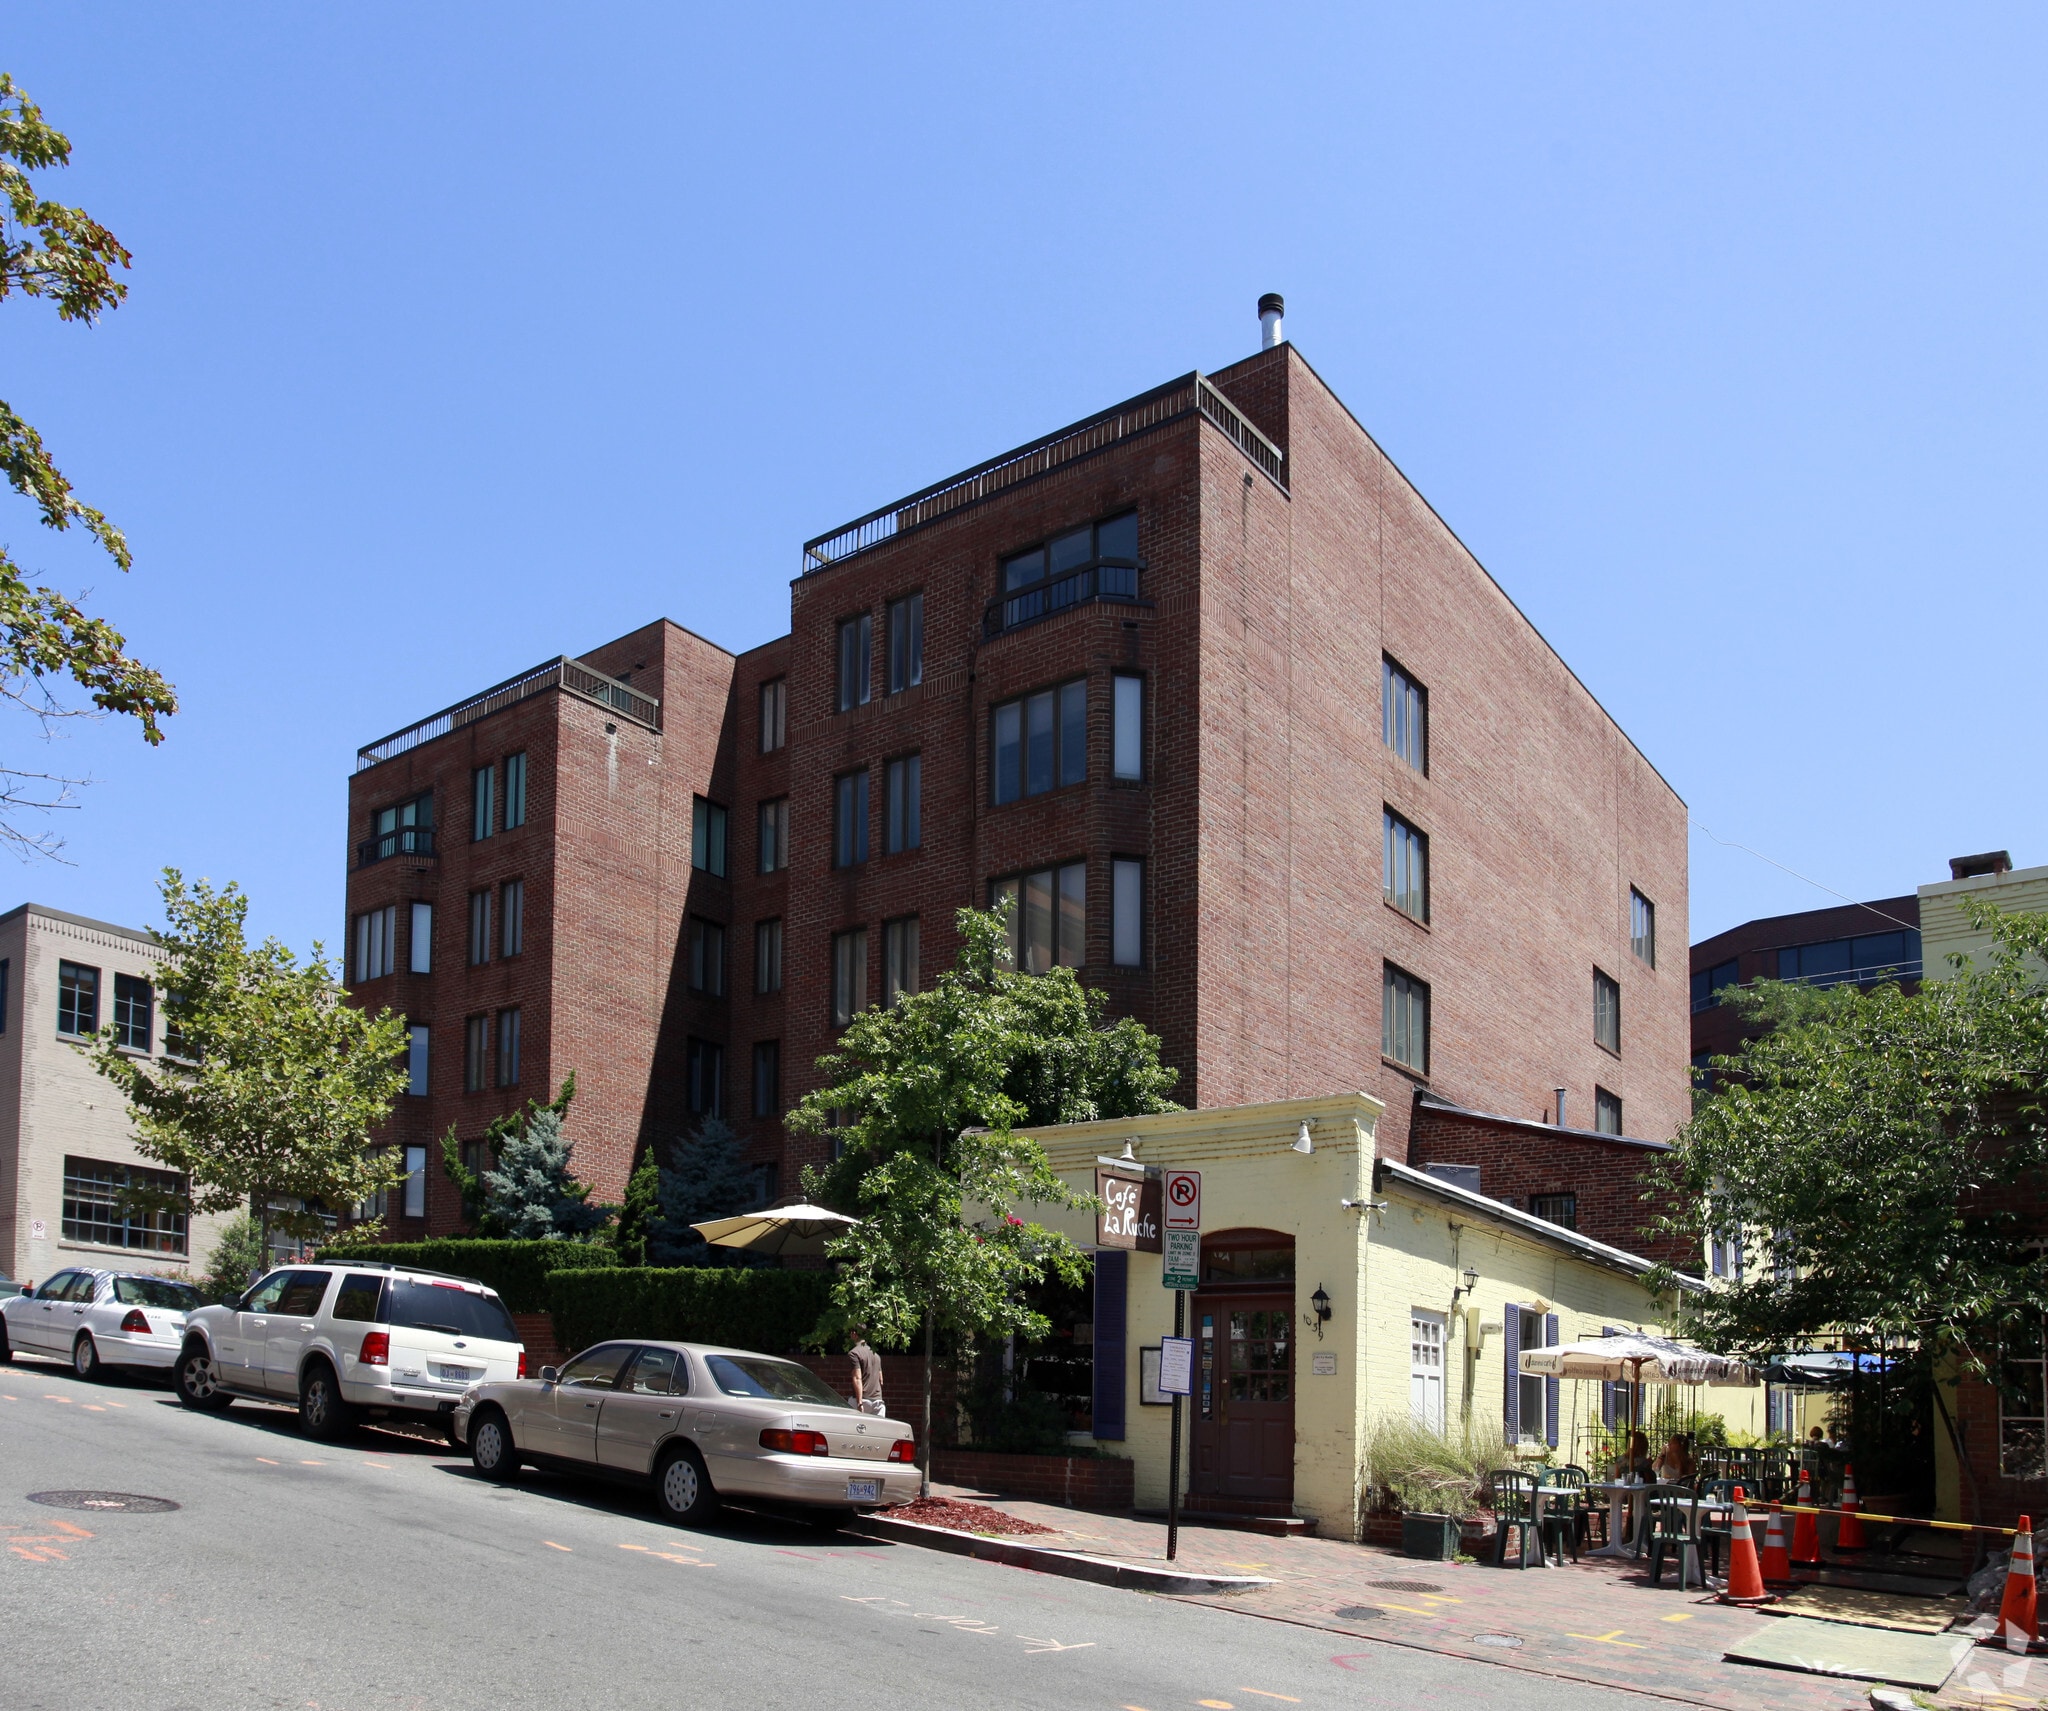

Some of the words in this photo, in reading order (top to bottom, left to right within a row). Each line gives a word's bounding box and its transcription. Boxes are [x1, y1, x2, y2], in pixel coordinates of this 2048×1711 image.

[1105, 1179, 1138, 1211] Café
[1104, 1210, 1120, 1235] La
[1121, 1207, 1156, 1239] Ruche
[1168, 1233, 1180, 1241] TWO
[1181, 1234, 1197, 1242] HOUR
[1170, 1242, 1193, 1251] PARKING
[1176, 1275, 1182, 1283] 2
